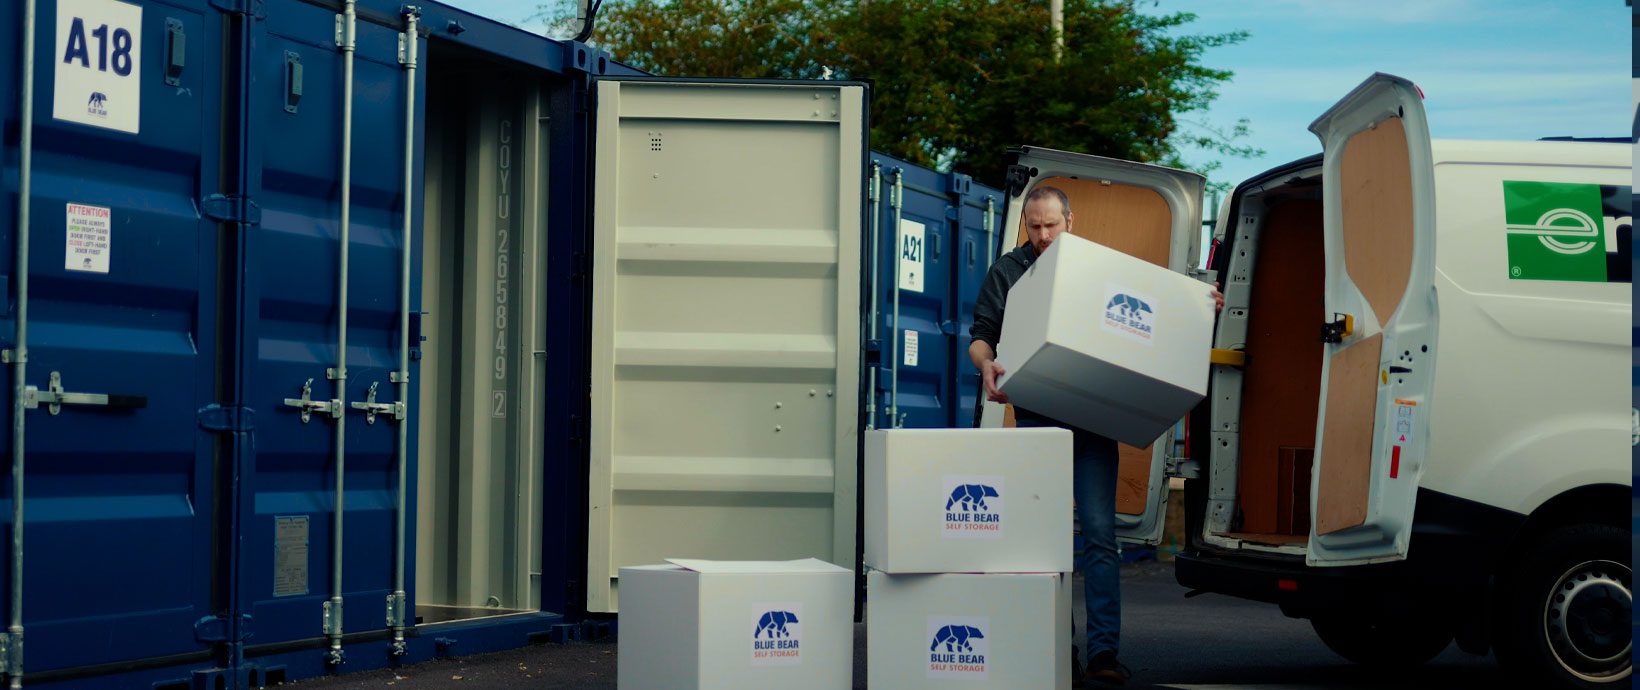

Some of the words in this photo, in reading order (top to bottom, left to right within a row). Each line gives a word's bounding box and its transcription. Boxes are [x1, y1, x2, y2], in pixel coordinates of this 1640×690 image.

[63, 16, 133, 77] A18
[499, 119, 512, 220] COYU
[68, 205, 109, 218] ATTENTION
[902, 234, 922, 263] A21
[495, 229, 508, 380] 265849
[1105, 311, 1127, 325] BLUE
[1129, 319, 1152, 333] BEAR
[493, 391, 507, 417] 2
[946, 513, 970, 522] BLUE
[974, 513, 999, 522] BEAR
[754, 640, 775, 649] BLUE
[777, 640, 799, 649] BEAR
[930, 663, 946, 671] SELF
[931, 653, 956, 663] BLUE
[958, 654, 985, 664] BEAR
